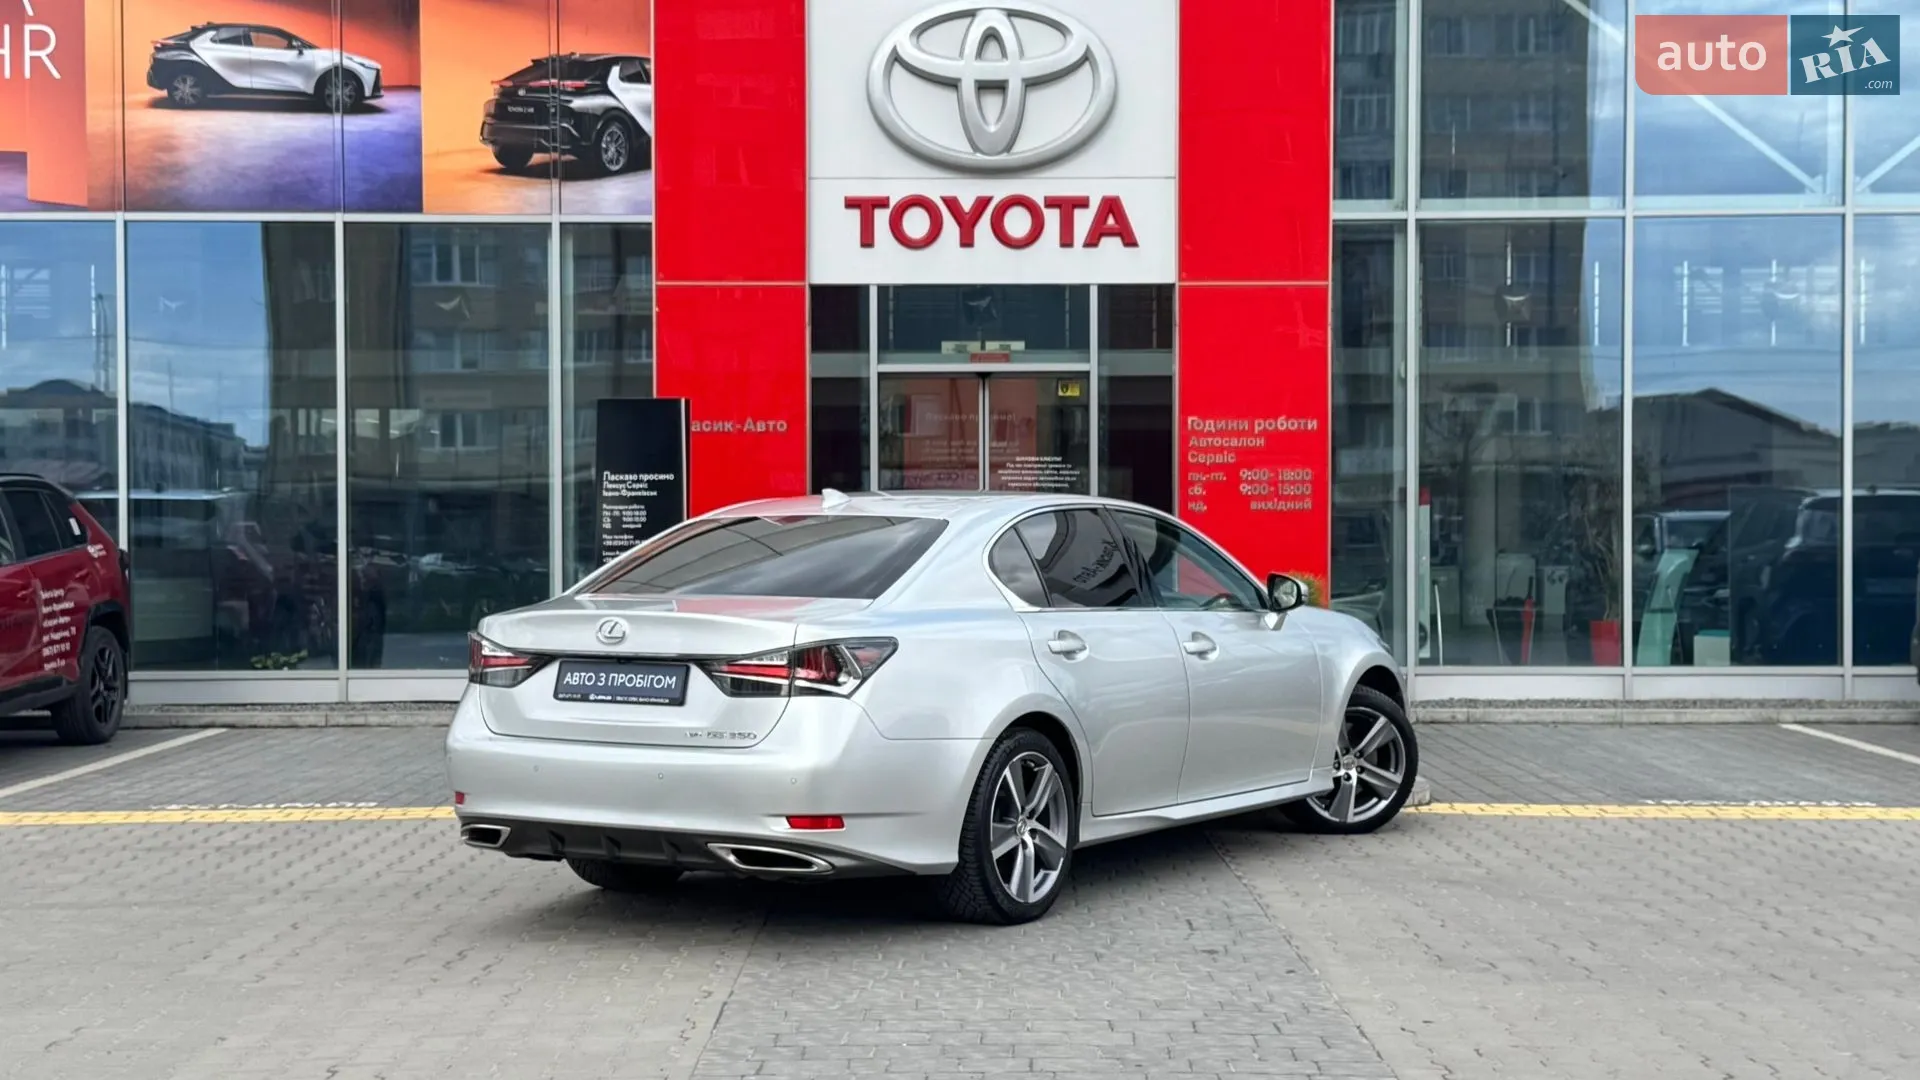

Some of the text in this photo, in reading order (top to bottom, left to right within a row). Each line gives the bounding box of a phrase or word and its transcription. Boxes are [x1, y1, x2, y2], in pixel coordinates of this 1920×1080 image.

[844, 194, 1139, 250] TOYOTA
[691, 416, 788, 432] асик-Авто
[1187, 415, 1318, 434] Години роботи
[1189, 436, 1265, 447] Автосалон
[1188, 450, 1236, 466] Сервіс
[639, 473, 675, 482] просимо
[1250, 498, 1312, 511] вихідний
[563, 672, 677, 689] АВТО З ПРОБІГОМ
